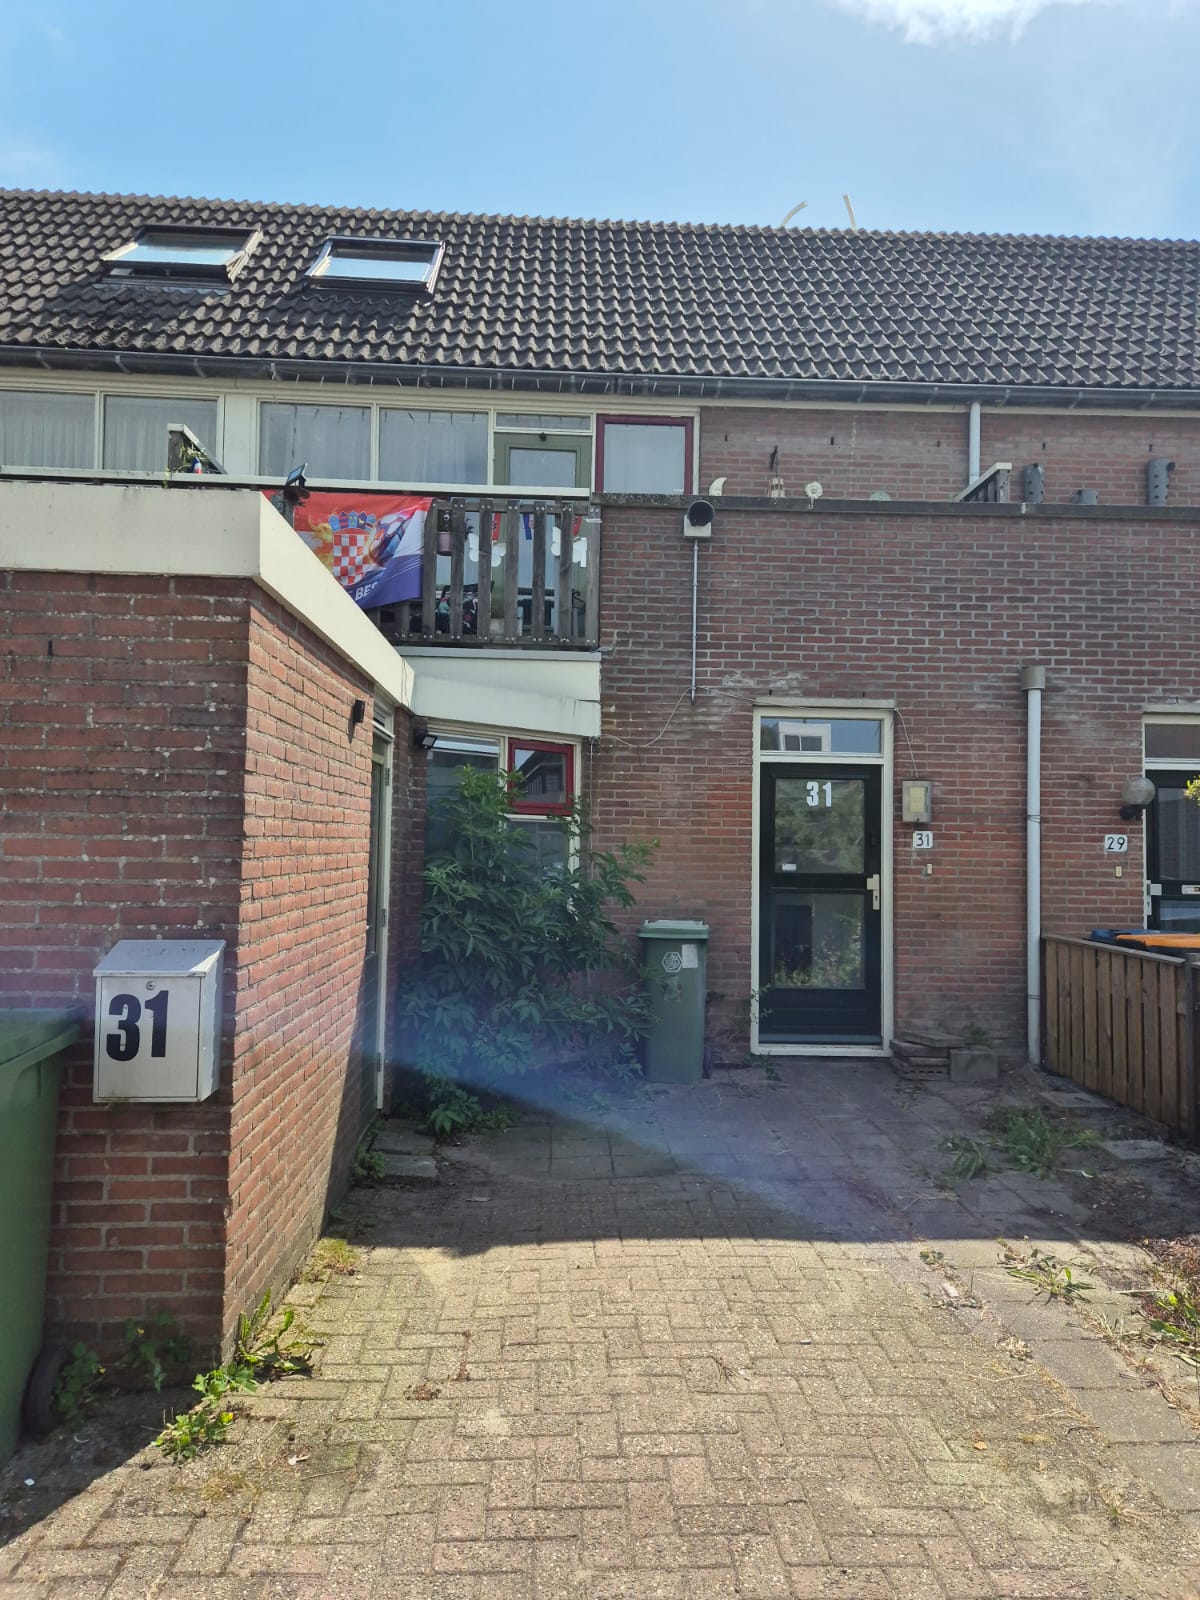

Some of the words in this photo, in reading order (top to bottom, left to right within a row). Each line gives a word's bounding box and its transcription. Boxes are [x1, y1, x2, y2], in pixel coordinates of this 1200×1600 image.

[806, 781, 832, 807] 31
[915, 832, 930, 847] 31
[1107, 836, 1126, 850] 29
[106, 990, 169, 1062] 31
